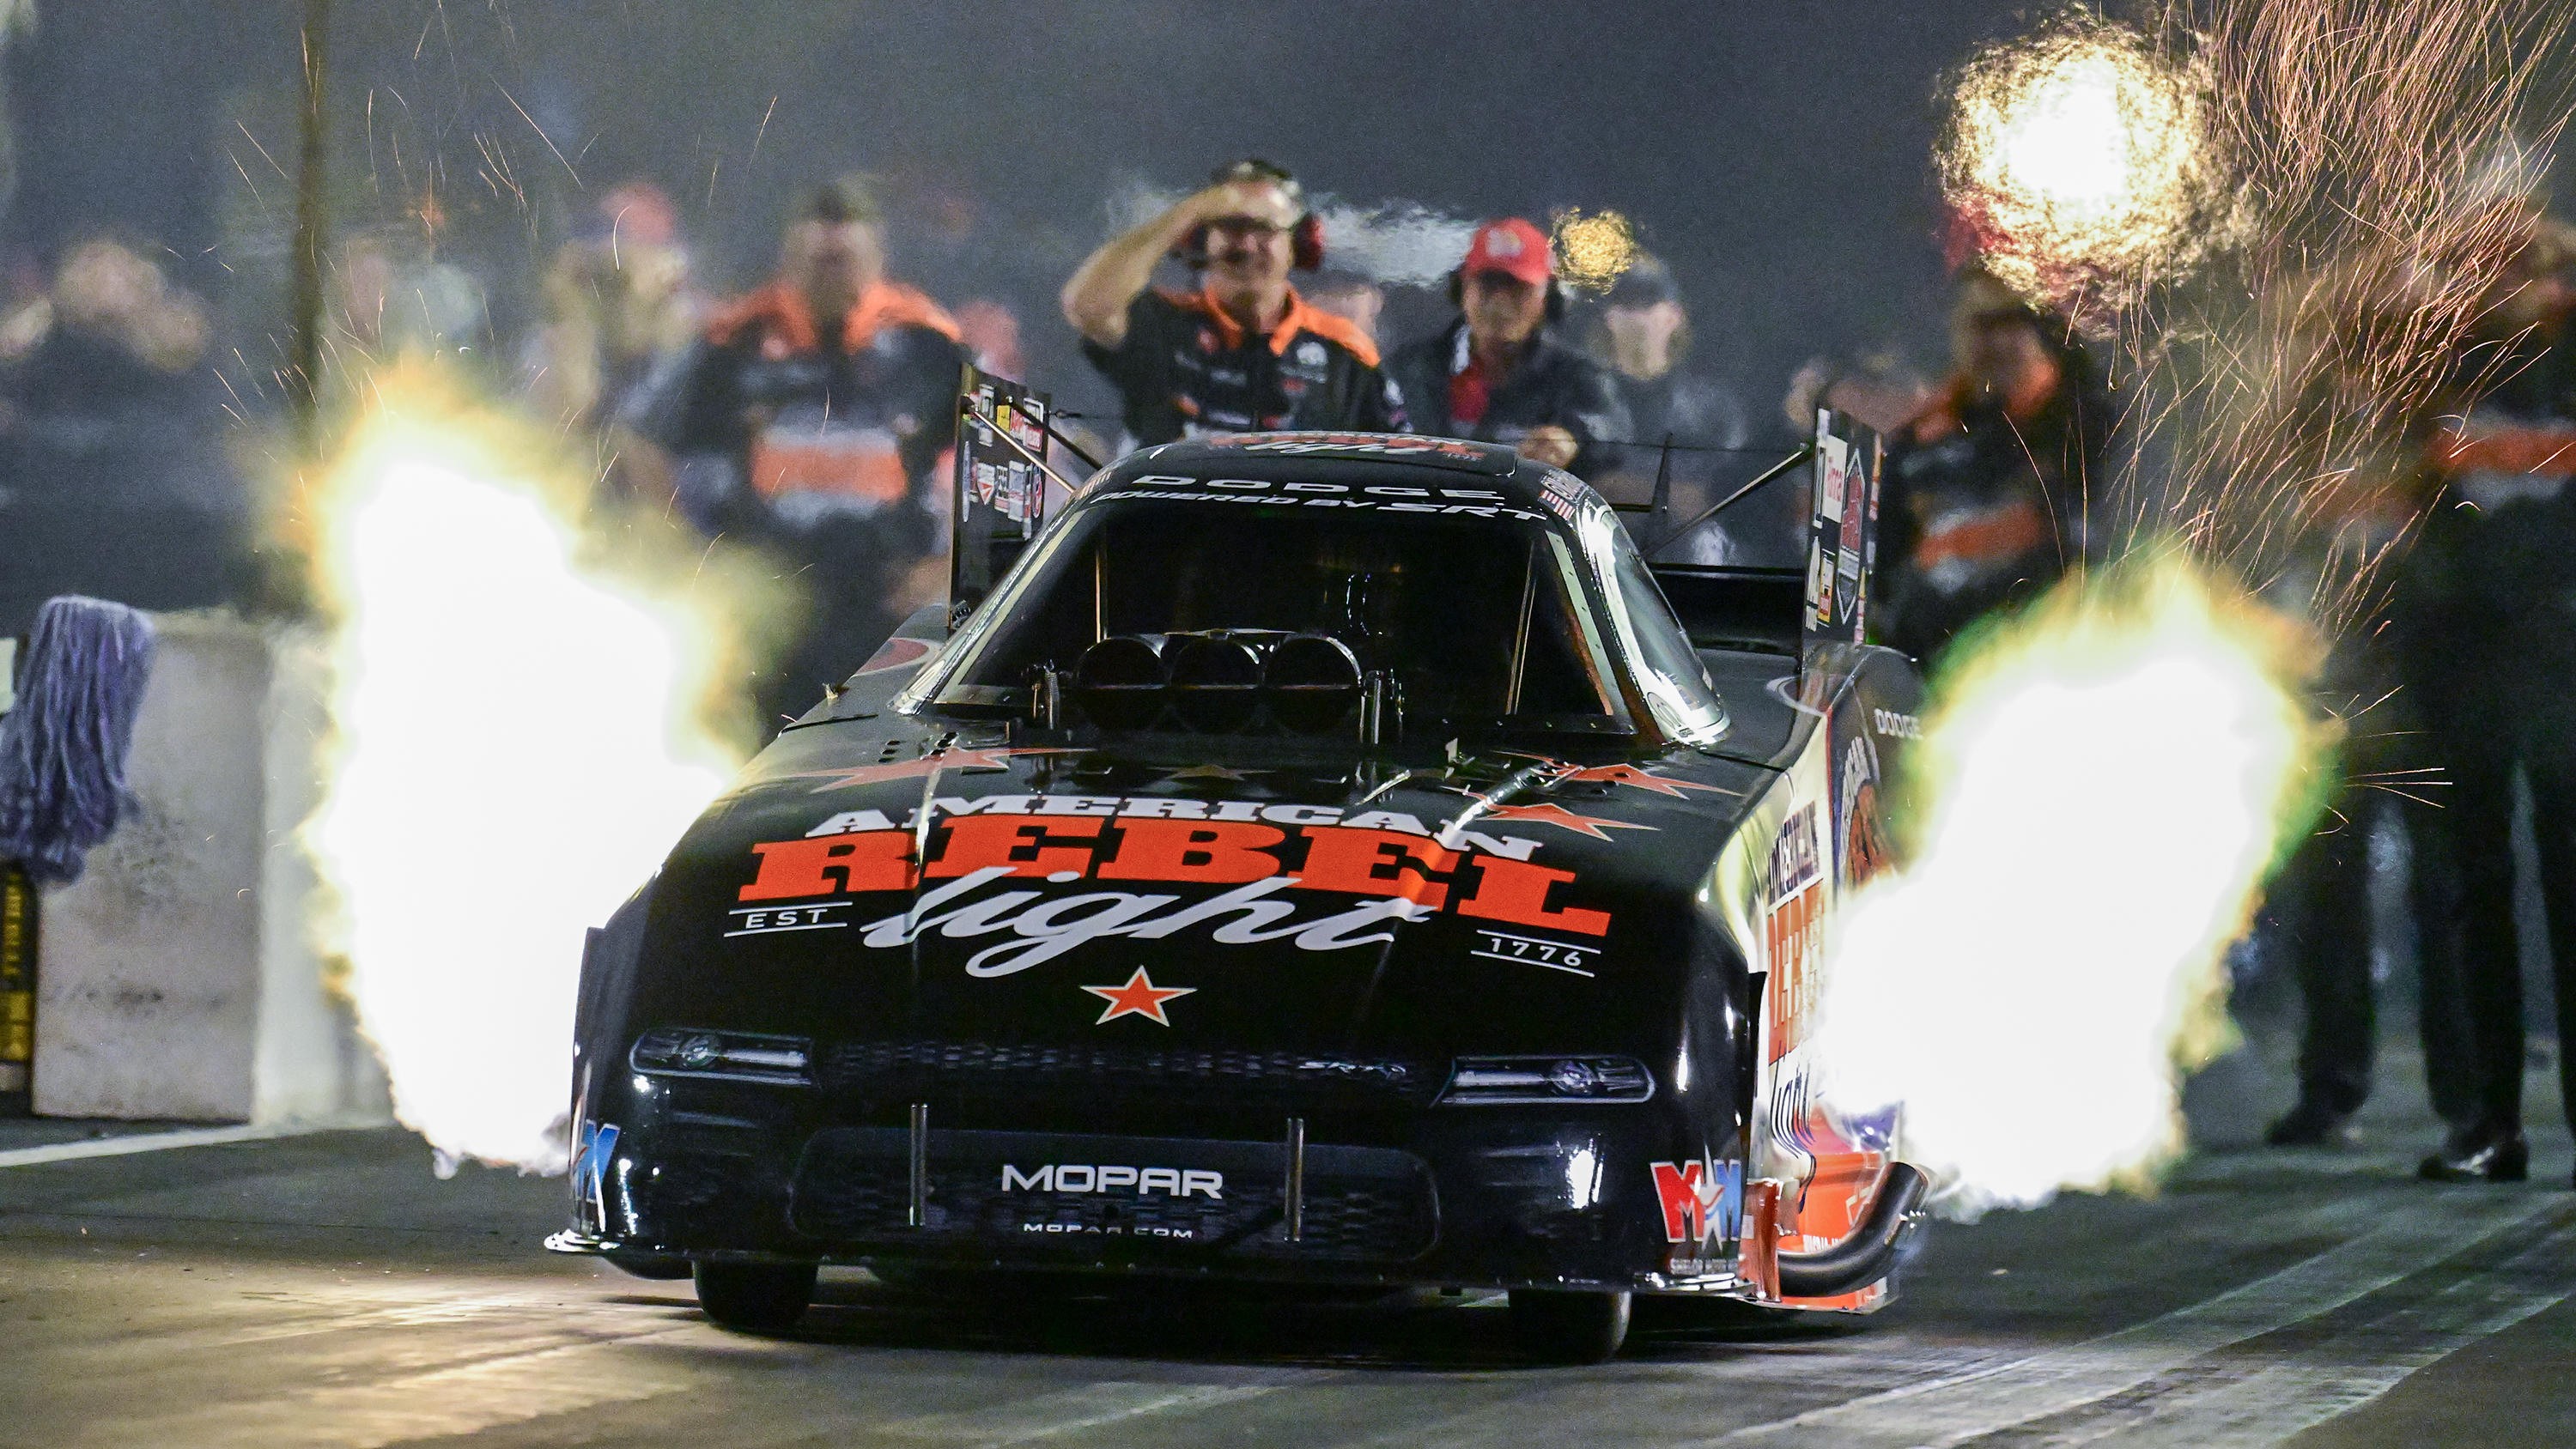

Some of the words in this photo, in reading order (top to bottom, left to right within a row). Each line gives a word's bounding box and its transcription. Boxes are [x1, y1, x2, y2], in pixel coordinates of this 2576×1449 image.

[1132, 475, 1505, 500] DODGE
[1089, 490, 1299, 505] POWERED
[1303, 498, 1376, 508] BY
[1376, 502, 1547, 521] SRT
[1874, 708, 1923, 740] DODGE
[805, 795, 1545, 861] AMERICAN
[738, 815, 1612, 937] REBEL
[745, 908, 828, 930] EST
[860, 867, 1438, 979] light
[1491, 937, 1583, 967] 1776
[1001, 1164, 1224, 1200] MOPAR
